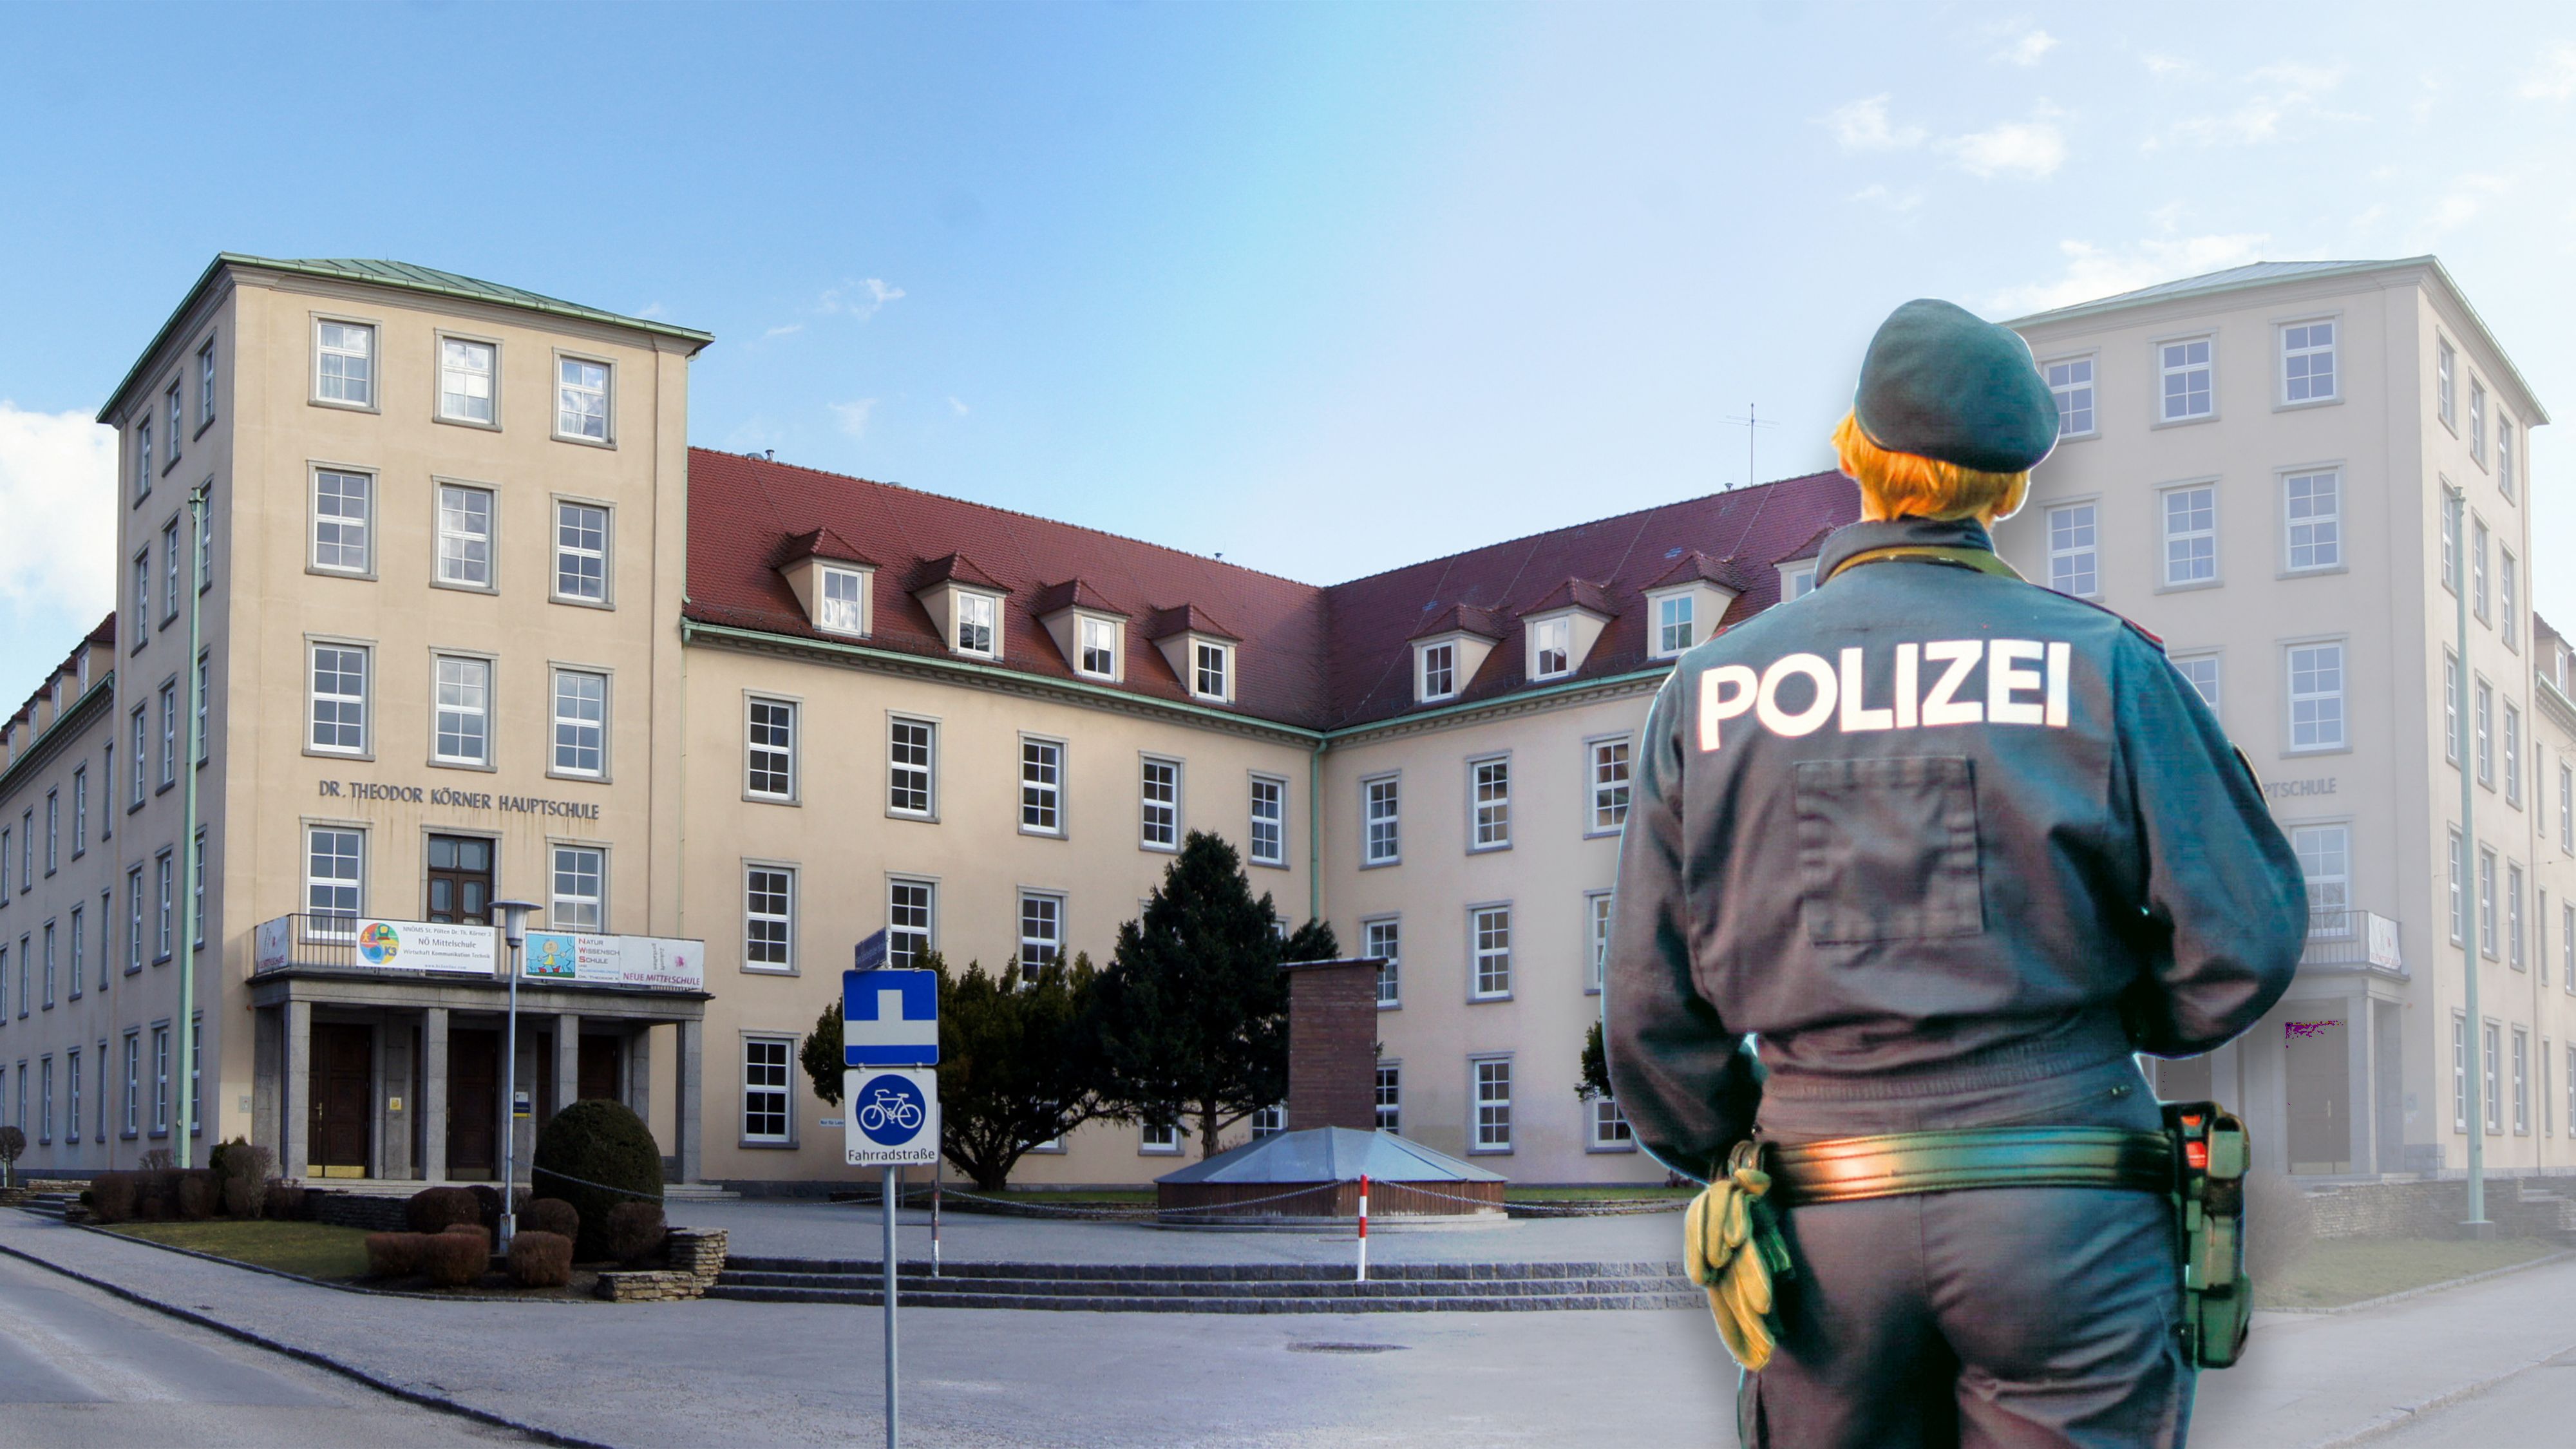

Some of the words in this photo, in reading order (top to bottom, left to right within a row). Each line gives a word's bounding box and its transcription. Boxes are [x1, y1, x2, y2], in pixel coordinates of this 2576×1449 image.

[1698, 639, 2071, 752] POLIZEI
[2262, 777, 2336, 798] PTSCHULE
[319, 780, 346, 798] DR.
[349, 781, 424, 803] THEODOR
[431, 786, 492, 810] KÖRNER
[498, 795, 600, 820] HAUPTSCHULE
[418, 937, 430, 946] NÖ
[432, 938, 477, 949] Mittelschule
[384, 946, 397, 957] K3
[431, 950, 471, 958] Kommunikation
[578, 947, 620, 956] WISSENSCH
[578, 956, 609, 964] SCHULE
[623, 972, 643, 981] NEUE
[646, 974, 700, 985] MITTELSCHULE
[848, 1148, 935, 1160] Fahrradstraße
